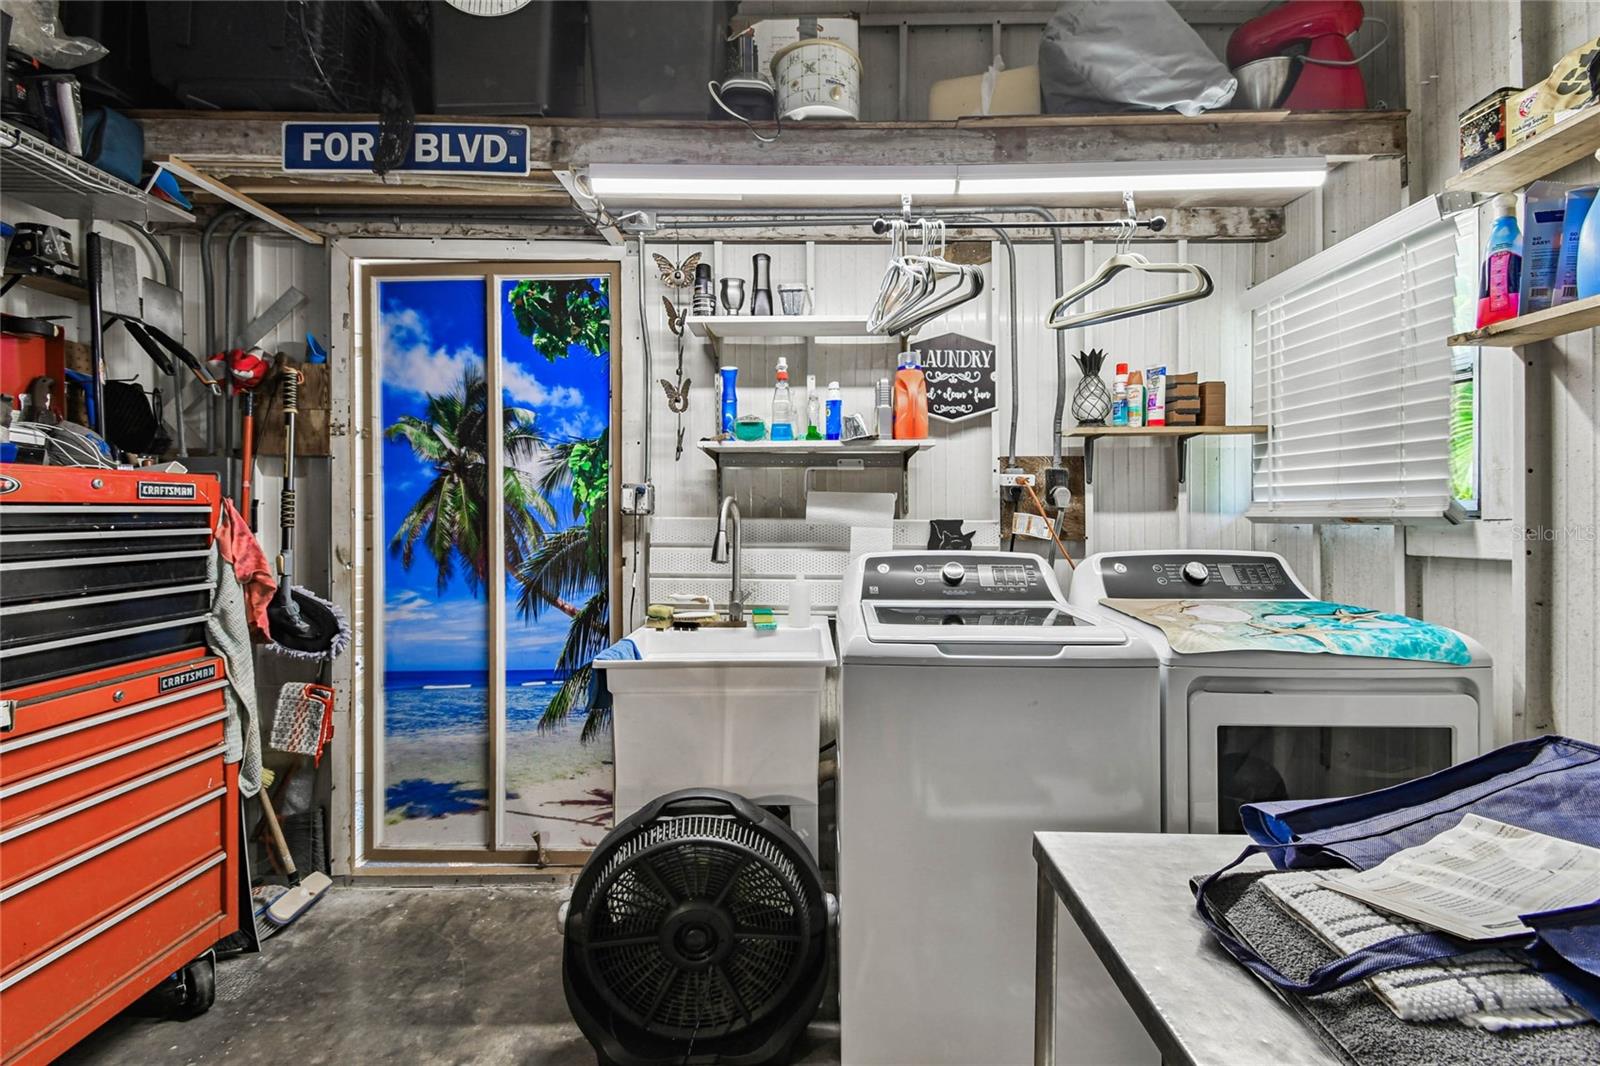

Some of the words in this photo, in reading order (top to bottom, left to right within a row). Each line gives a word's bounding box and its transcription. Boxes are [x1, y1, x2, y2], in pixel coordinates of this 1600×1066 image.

[303, 132, 376, 162] FOR
[414, 133, 518, 164] BLVD.
[915, 349, 993, 368] LAUNDRY
[974, 387, 991, 403] fun
[142, 485, 193, 496] CRAFTSMAN
[162, 666, 215, 689] CRAFTSMAN
